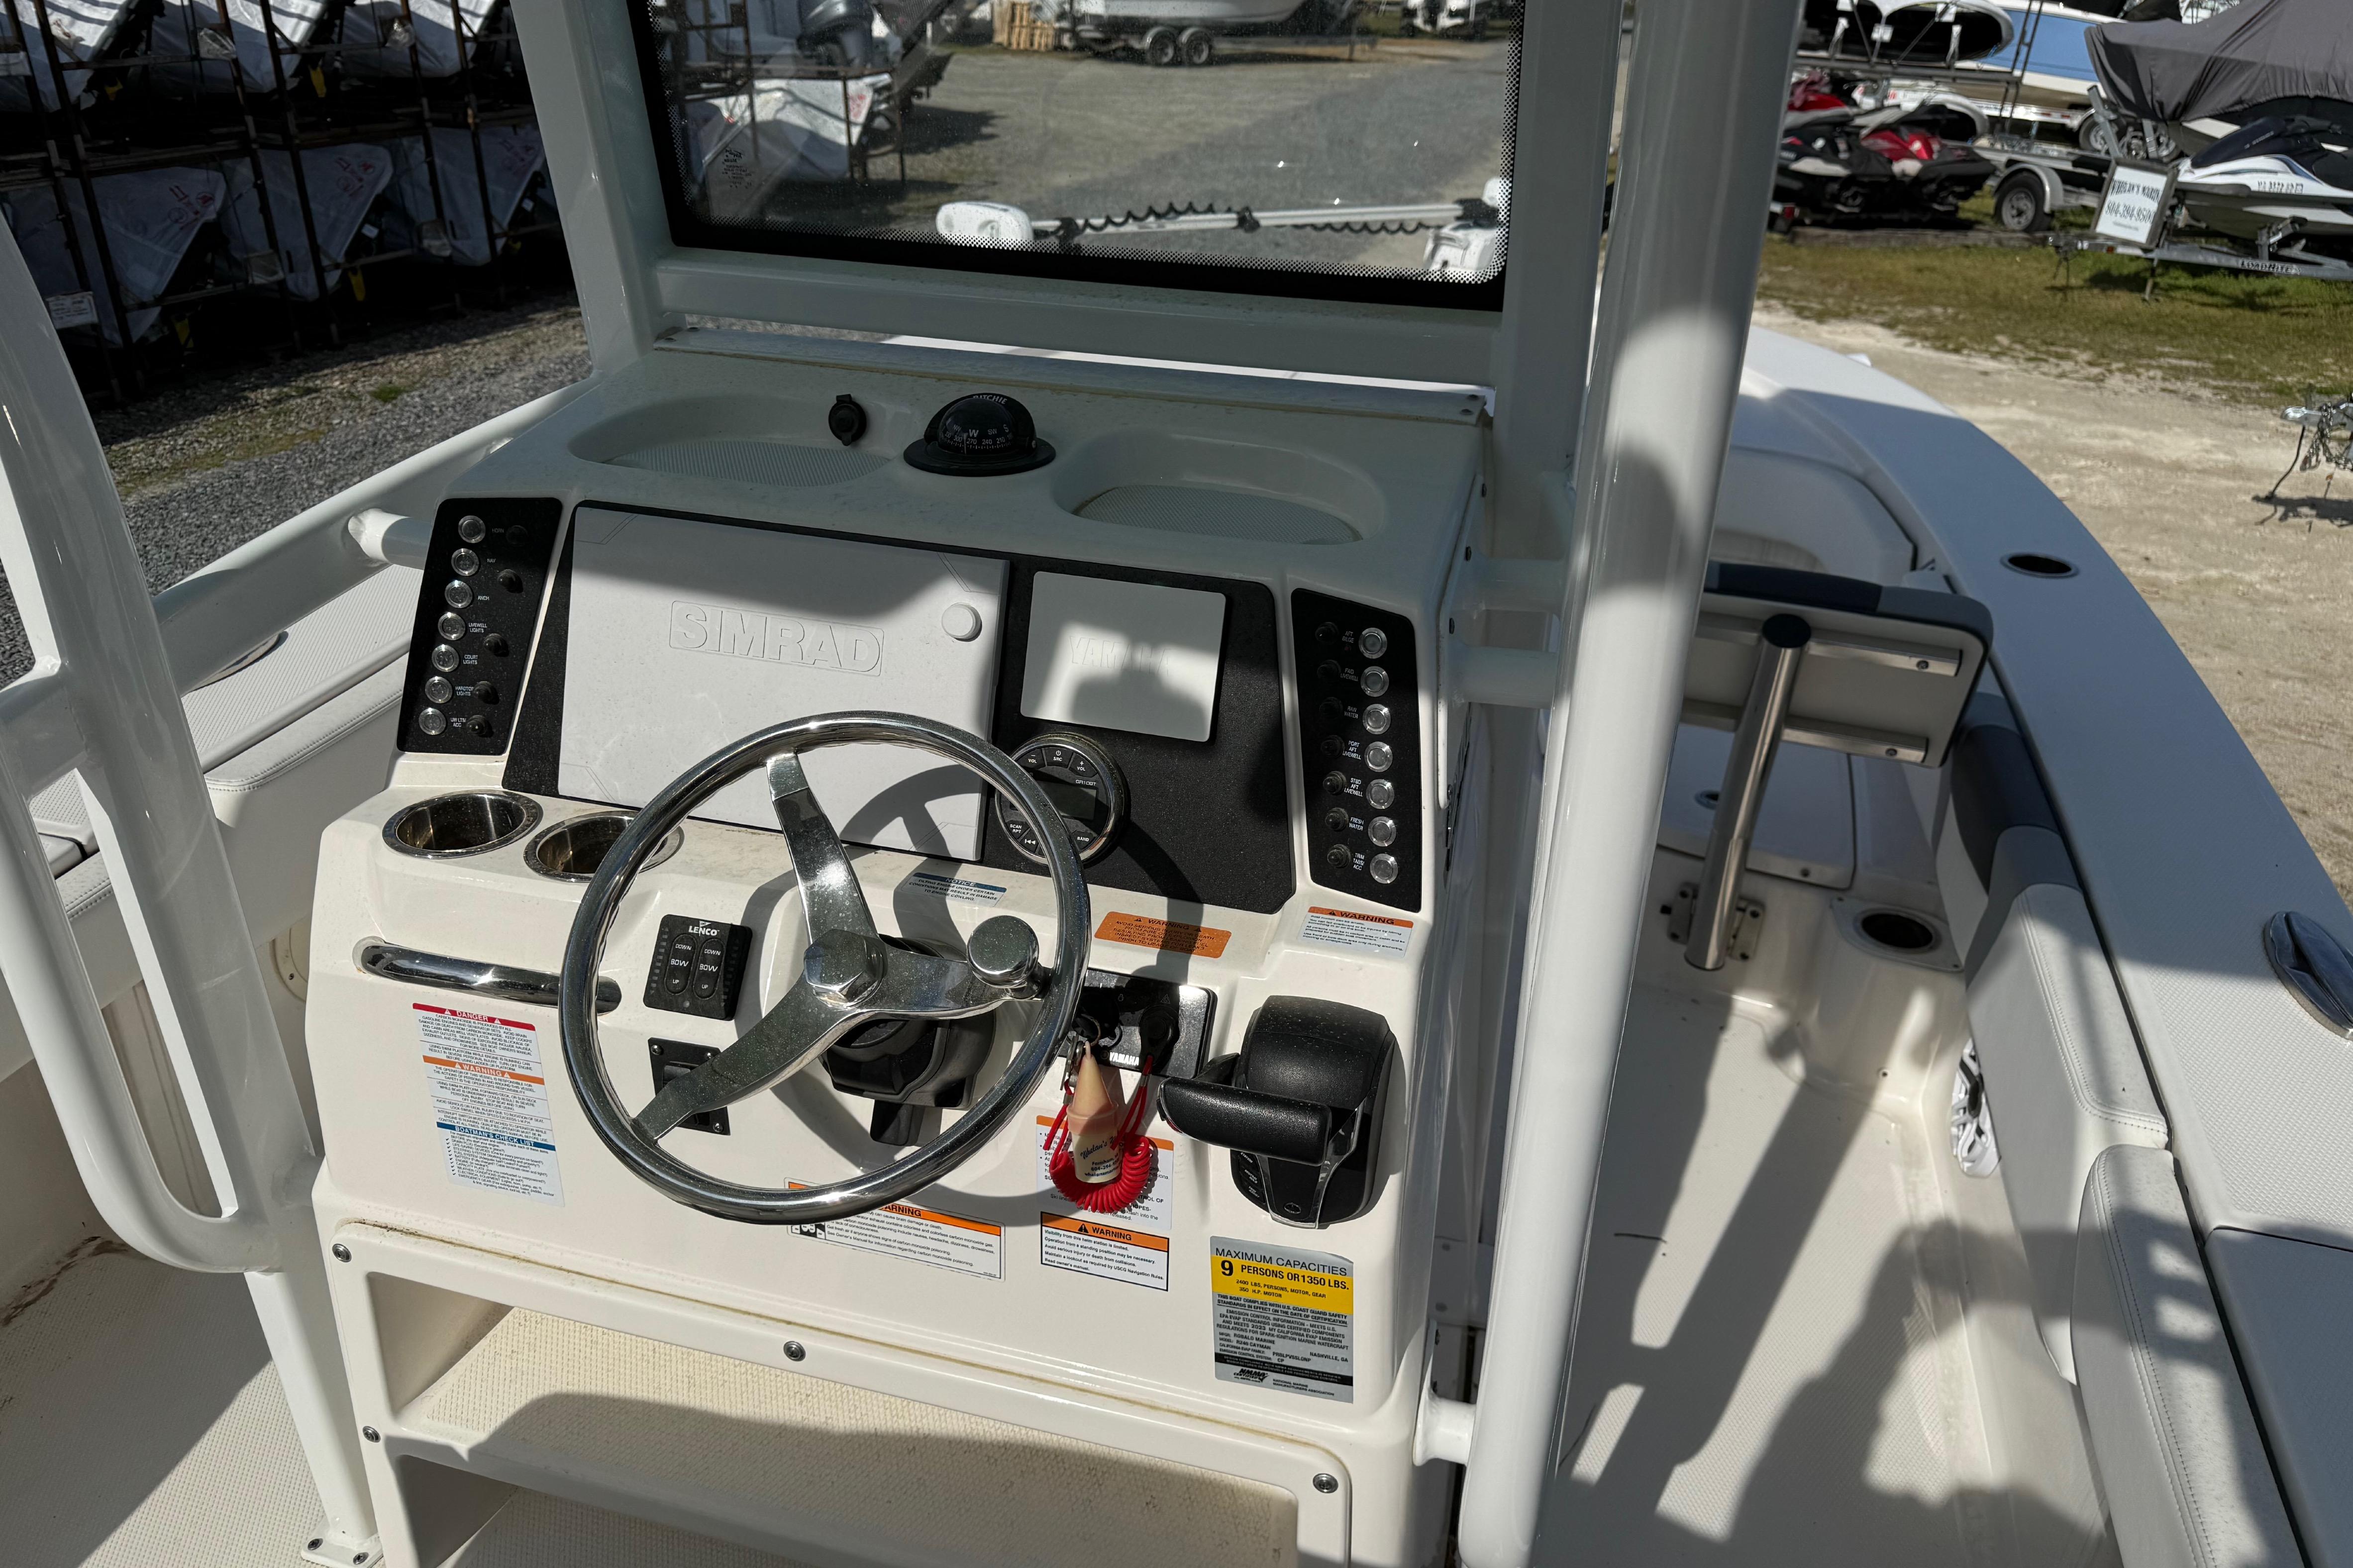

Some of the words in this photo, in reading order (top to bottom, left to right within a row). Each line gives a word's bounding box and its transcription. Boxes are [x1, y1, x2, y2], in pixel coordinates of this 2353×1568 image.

[969, 429, 979, 437] W
[673, 604, 881, 673] SIMRAD
[1340, 673, 1358, 682] LIVEWELL
[1342, 751, 1361, 760] LIVEWELL
[1344, 787, 1363, 797] LIVEWELL
[1350, 816, 1364, 825] FRESH
[1349, 822, 1363, 831] WATER
[944, 878, 976, 886] NOTICE
[1340, 911, 1395, 925] WARNING
[1147, 919, 1189, 930] WARNING
[688, 925, 718, 936] LENCO
[670, 959, 689, 967] BOW
[699, 964, 718, 972] BOW
[456, 1010, 489, 1022] DANGER
[1109, 1051, 1139, 1066] YAMAHA
[462, 1063, 503, 1078] WARNING
[455, 1126, 494, 1140] BOATMAN'S
[495, 1133, 518, 1145] CHECK
[519, 1137, 535, 1147] LIST
[1080, 1140, 1108, 1160] Whelan's
[884, 1203, 922, 1218] ARNING
[1092, 1226, 1131, 1241] WARNING
[1044, 1236, 1065, 1245] Operation
[1132, 1256, 1155, 1264] necessary.
[1215, 1247, 1272, 1264] MAXIMUM
[1276, 1257, 1346, 1276] CAPACITIES
[1127, 1269, 1150, 1277] Navigation
[1221, 1259, 1233, 1277] 9
[1240, 1264, 1284, 1279] PERSONS
[1328, 1278, 1349, 1290] LBS.
[1263, 1283, 1289, 1292] PERSONS,
[1217, 1299, 1246, 1308] STANDARDS
[1309, 1352, 1339, 1361] NASHVILLE,
